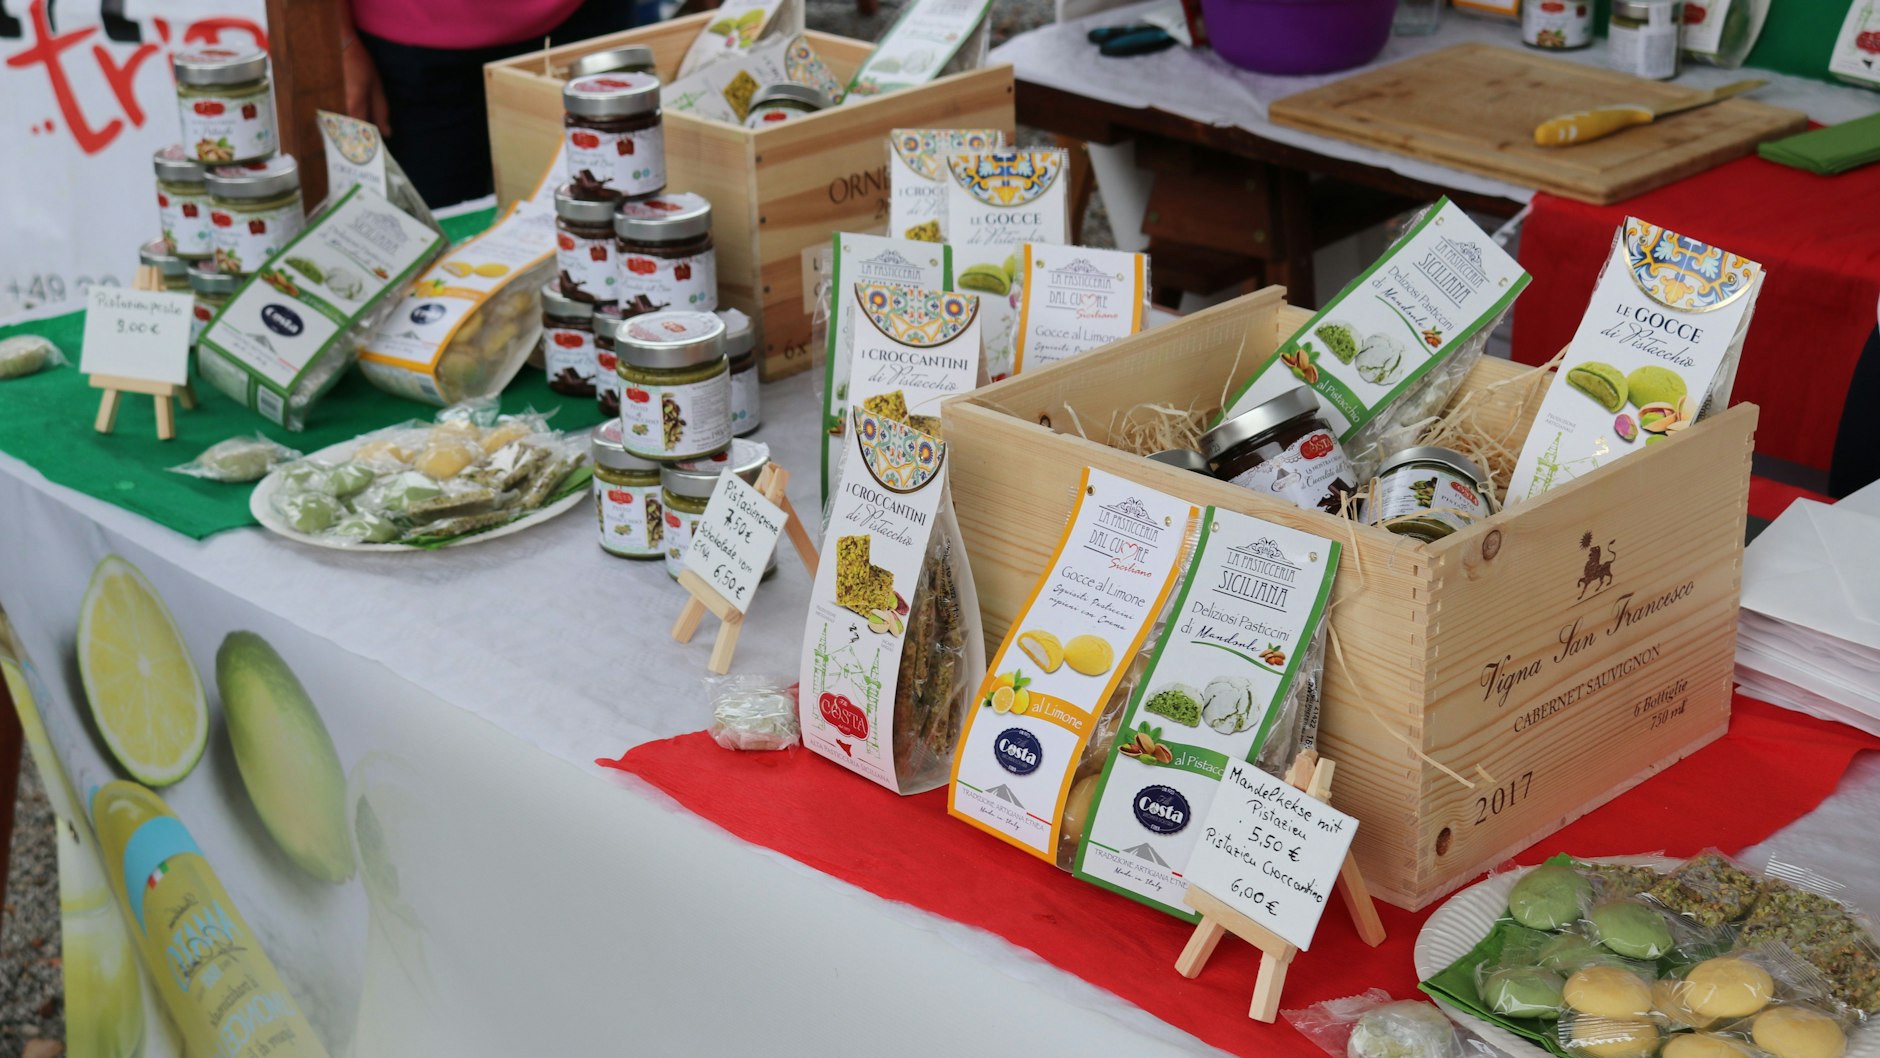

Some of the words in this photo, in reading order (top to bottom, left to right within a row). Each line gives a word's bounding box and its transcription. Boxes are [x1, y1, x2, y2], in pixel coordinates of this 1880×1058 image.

[985, 212, 1042, 225] GOCCE
[874, 265, 921, 280] PASTICCERIA
[1051, 272, 1062, 285] LA
[1064, 273, 1112, 289] PASTICCERIA
[1372, 276, 1387, 289] di
[1418, 253, 1471, 304] SICILIANA
[1435, 241, 1447, 255] LA
[1445, 249, 1488, 289] PASTICCERIA
[1049, 291, 1066, 305] DAL
[1076, 309, 1119, 319] Siciliano
[1388, 265, 1424, 299] Deliziosi
[1419, 294, 1458, 331] Pasticcini
[1036, 325, 1070, 340] Gocce
[1071, 326, 1082, 340] al
[1616, 303, 1632, 318] LE
[1634, 306, 1704, 345] GOCCE
[868, 348, 968, 371] CROCCANTINI
[1600, 321, 1625, 338] di
[1620, 321, 1697, 368] Pistacchio
[868, 364, 886, 383] di
[887, 363, 959, 391] Pistacchio
[1316, 378, 1329, 392] al
[1327, 384, 1361, 424] Pistacchio
[724, 480, 779, 536] Pistaziencreme
[846, 482, 850, 492] I
[852, 483, 927, 526] CROCCANTINI
[846, 503, 864, 521] di
[860, 503, 914, 546] Pistacchio
[1088, 529, 1108, 549] DAL
[1098, 509, 1112, 525] LA
[1111, 513, 1159, 543] PASTICCERIA
[700, 521, 737, 561] Schokolade
[738, 556, 753, 574] vom
[1108, 558, 1153, 578] Siciliano
[1226, 551, 1239, 566] LA
[1240, 554, 1296, 583] PASTICCERIA
[1052, 584, 1088, 603] Squisiti
[1090, 598, 1136, 620] Pasticcini
[1061, 565, 1096, 588] Gocce
[1095, 577, 1110, 592] al
[1107, 582, 1146, 608] Limone
[1218, 570, 1289, 608] SICILIANA
[1048, 596, 1079, 612] ripieni
[1081, 609, 1096, 619] con
[1097, 615, 1127, 631] Crema
[1191, 601, 1239, 626] Deliziosi
[1238, 615, 1293, 642] Pasticcini
[1180, 618, 1194, 635] di
[1195, 625, 1261, 652] Mandorle
[1480, 654, 1543, 708] Vigna
[1553, 616, 1597, 664] San
[1606, 580, 1695, 636] Francesco
[1513, 686, 1586, 733] CABERNET
[1585, 643, 1663, 696] SAUVIGNON
[1633, 704, 1642, 718] 6
[1641, 678, 1689, 712] Bottiglie
[821, 698, 867, 735] COSTA
[1031, 697, 1045, 713] al
[1044, 704, 1084, 730] Limone
[1649, 711, 1668, 731] 750
[1669, 697, 1688, 721] ml
[824, 745, 860, 769] PASTICCERIA
[861, 763, 891, 785] SICILIANA
[999, 738, 1037, 766] Costa
[1174, 751, 1185, 767] al
[962, 787, 996, 811] TRADIZIONE
[996, 801, 1027, 825] ARTIGIANA
[1026, 817, 1045, 832] ETNEA
[1139, 796, 1184, 824] Costa
[1228, 766, 1313, 822] Mandelkekse
[1317, 818, 1343, 834] mit
[1474, 770, 1534, 826] 2017
[979, 806, 996, 818] Made
[1005, 817, 1021, 831] Italy
[1246, 799, 1307, 841] Pistazien
[1094, 848, 1134, 869] TRADIZIONE
[1134, 861, 1170, 884] ARTIGIANA
[1113, 867, 1132, 879] Made
[1144, 878, 1163, 892] Italy
[1205, 827, 1257, 868] Pistazien
[1262, 860, 1323, 903] Croccantino
